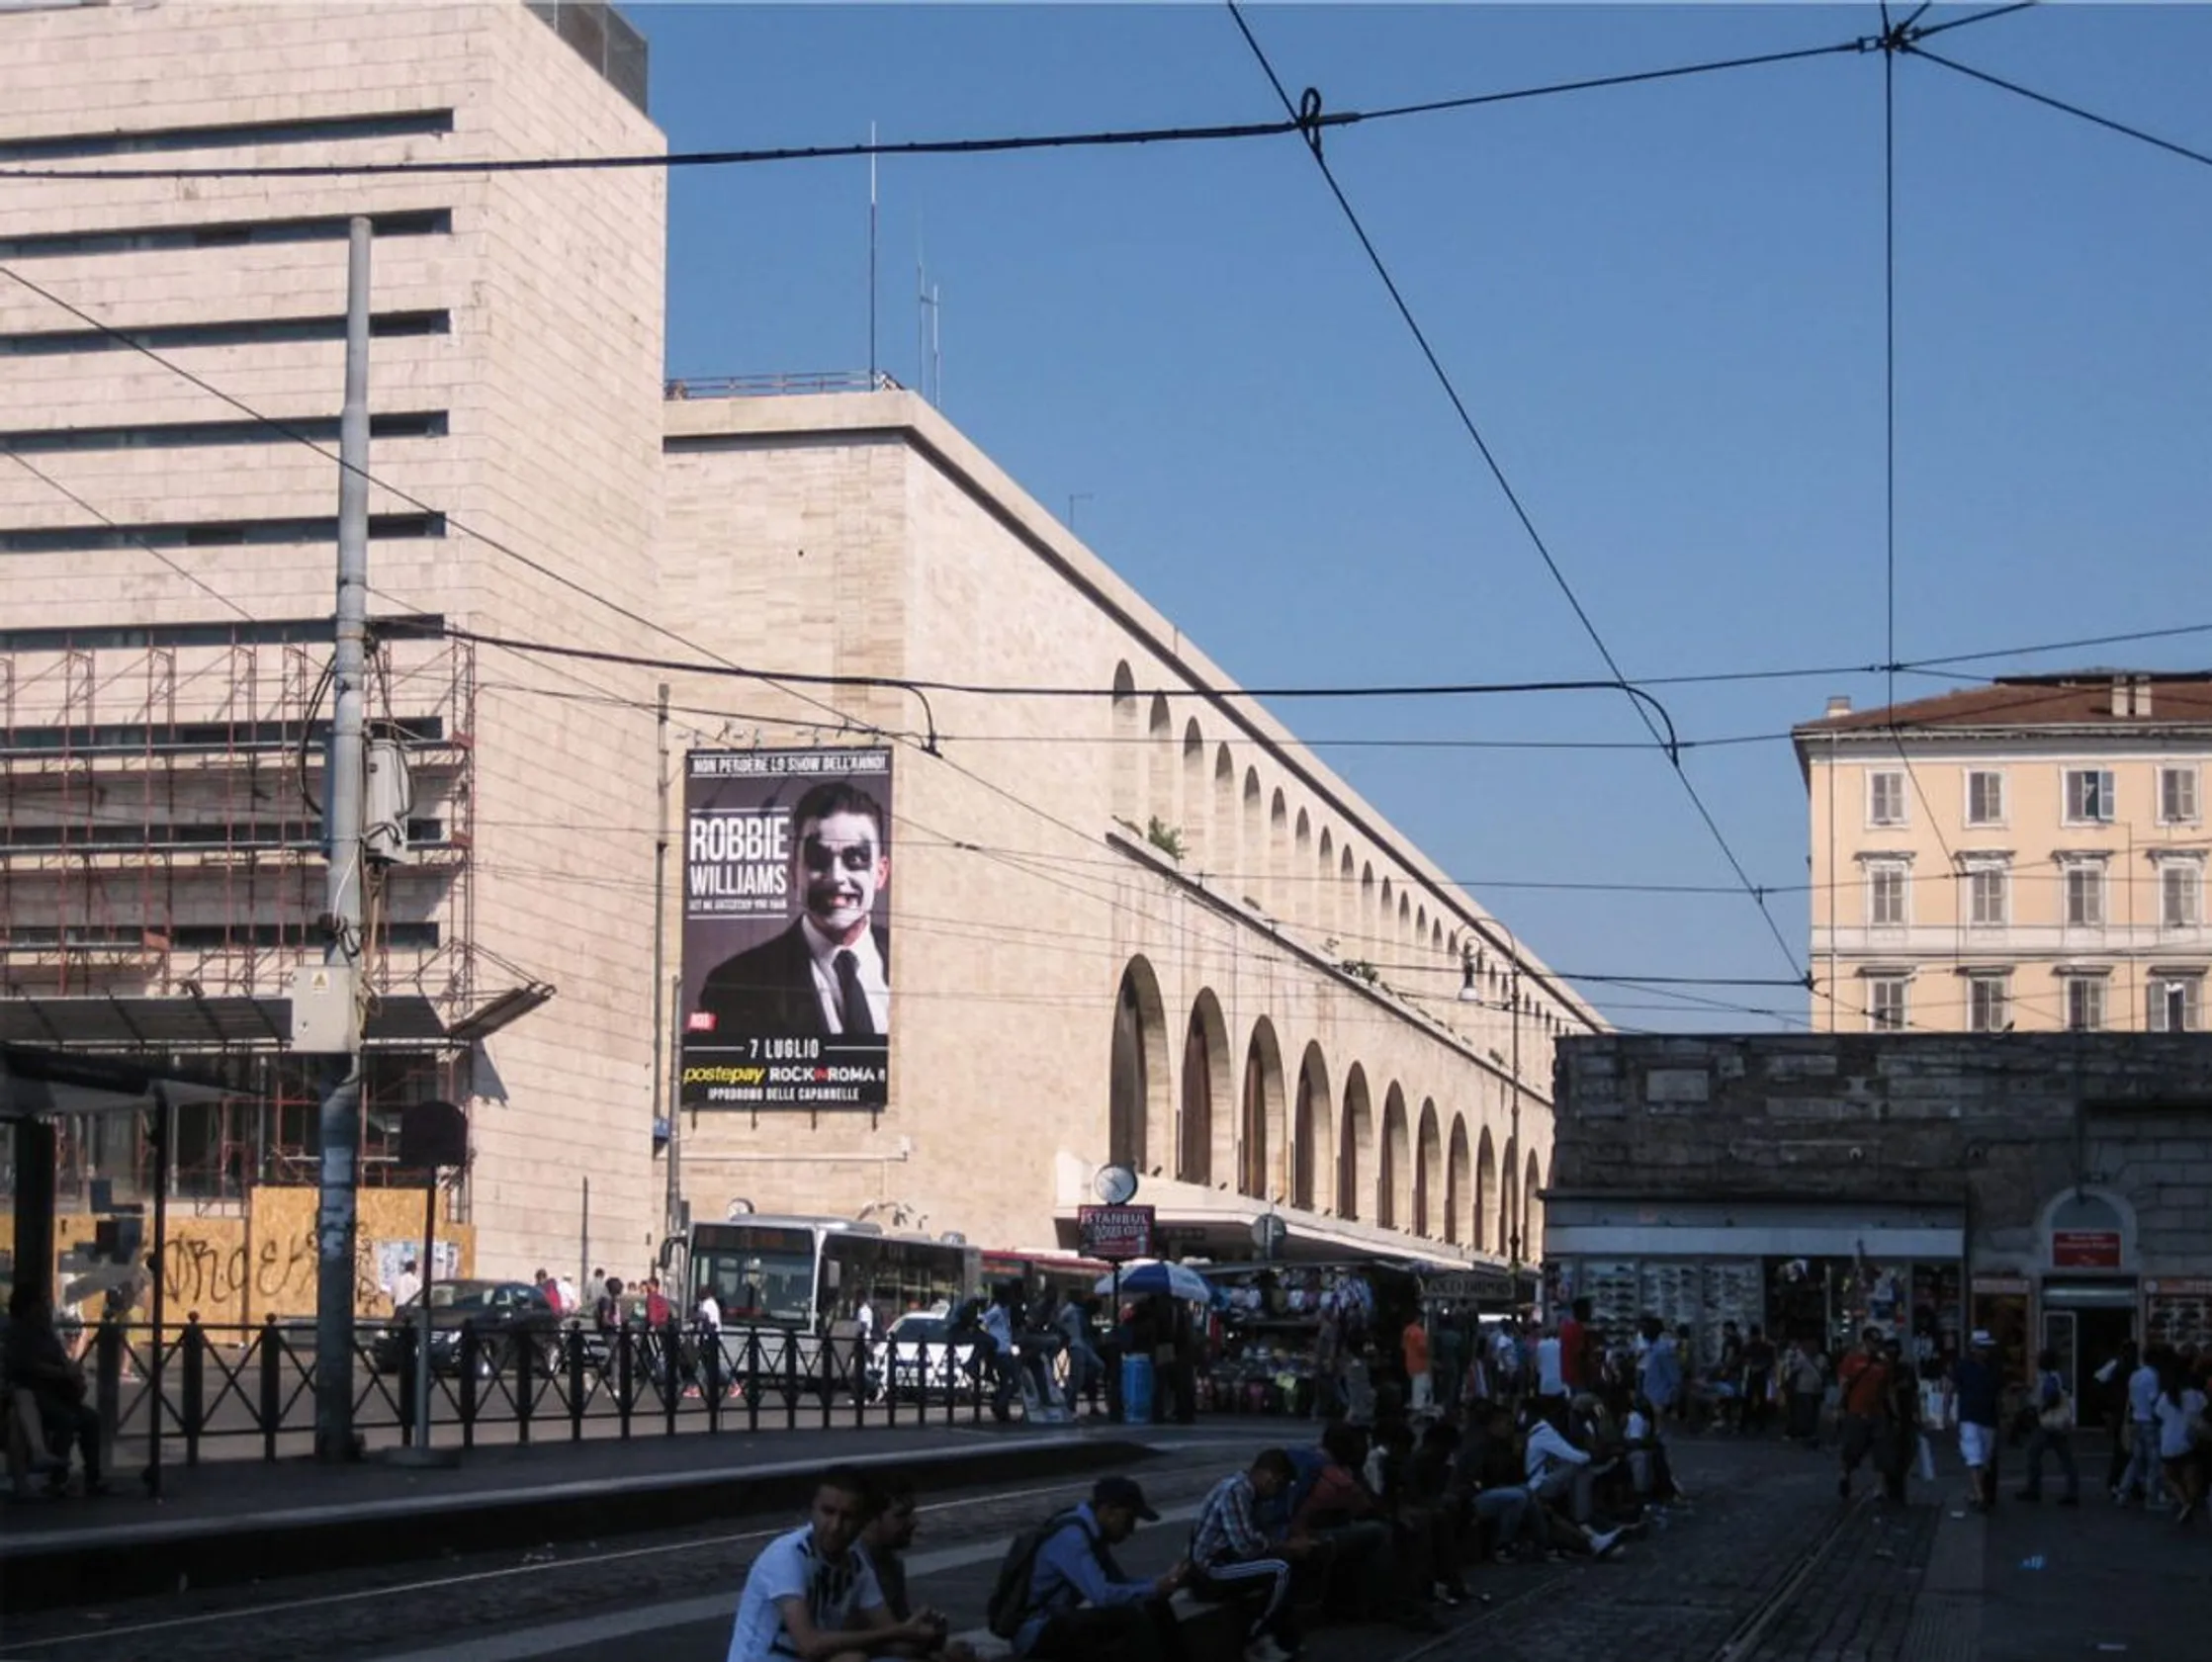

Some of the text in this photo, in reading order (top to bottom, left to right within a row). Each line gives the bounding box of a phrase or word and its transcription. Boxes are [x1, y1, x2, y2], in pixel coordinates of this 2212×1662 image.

[690, 817, 789, 861] ROBBIE
[690, 864, 787, 896] WILLIAMS
[750, 1038, 820, 1059] 7 LUGLIO
[683, 1065, 764, 1085] postepay
